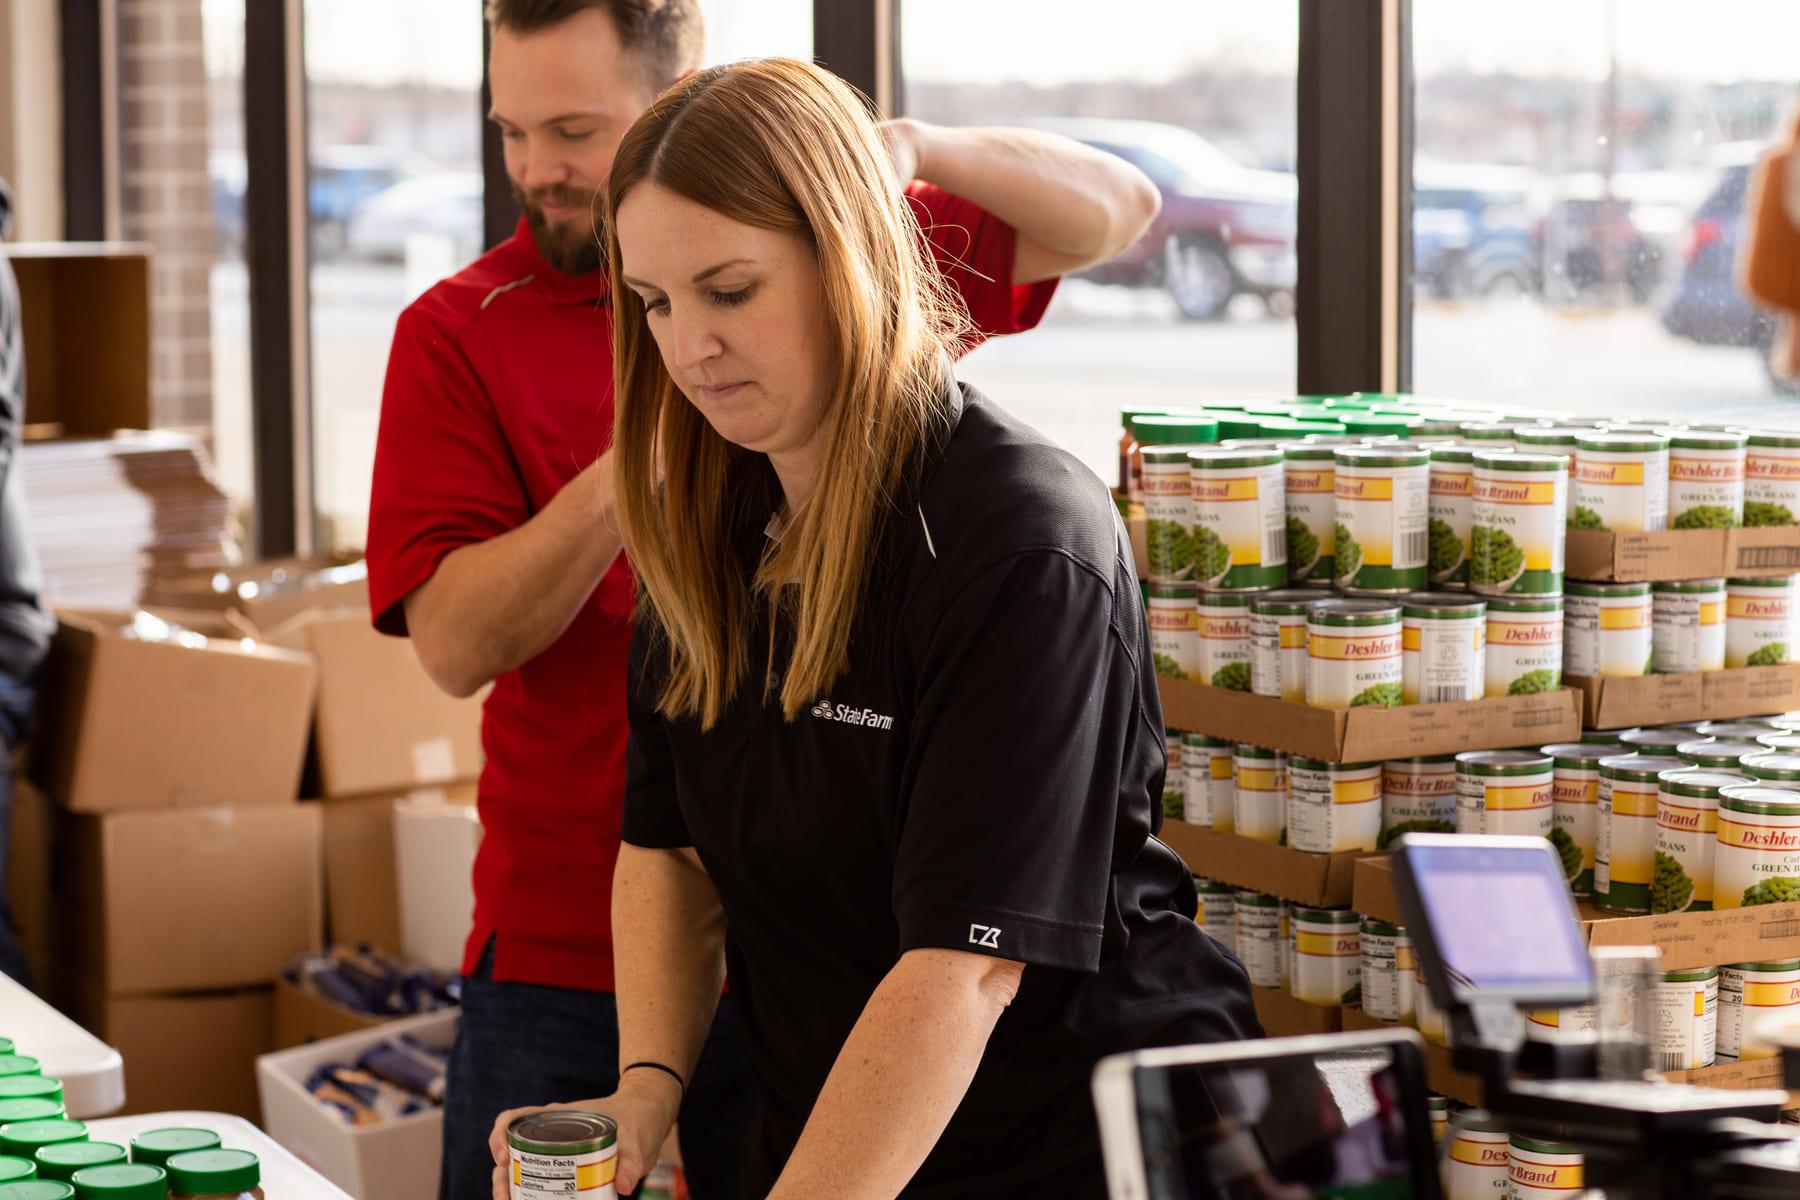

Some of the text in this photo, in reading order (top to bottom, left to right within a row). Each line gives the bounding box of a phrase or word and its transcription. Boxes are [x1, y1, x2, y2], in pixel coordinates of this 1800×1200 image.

[1672, 463, 1721, 477] Deshler
[1769, 463, 1800, 475] Bran
[1160, 479, 1190, 491] Bran
[1430, 478, 1469, 491] Brand
[1489, 486, 1529, 500] Brand
[1429, 506, 1457, 516] EANS
[1205, 621, 1249, 635] Deshler
[1505, 626, 1553, 641] Deshler
[1344, 640, 1393, 657] Deshler
[1356, 672, 1390, 682] GREEN
[1434, 780, 1456, 791] Bra
[1391, 807, 1456, 816] GREEN BEAN
[1662, 810, 1700, 827] Brand
[1742, 830, 1797, 846] Deshler
[1658, 839, 1686, 853] BEANS
[1752, 863, 1791, 873] GREEN
[1724, 970, 1743, 980] Facts
[1732, 994, 1743, 1004] 20
[520, 1155, 575, 1167] Nutrition Facts
[1516, 1168, 1557, 1183] Brand
[564, 1182, 576, 1191] 20
